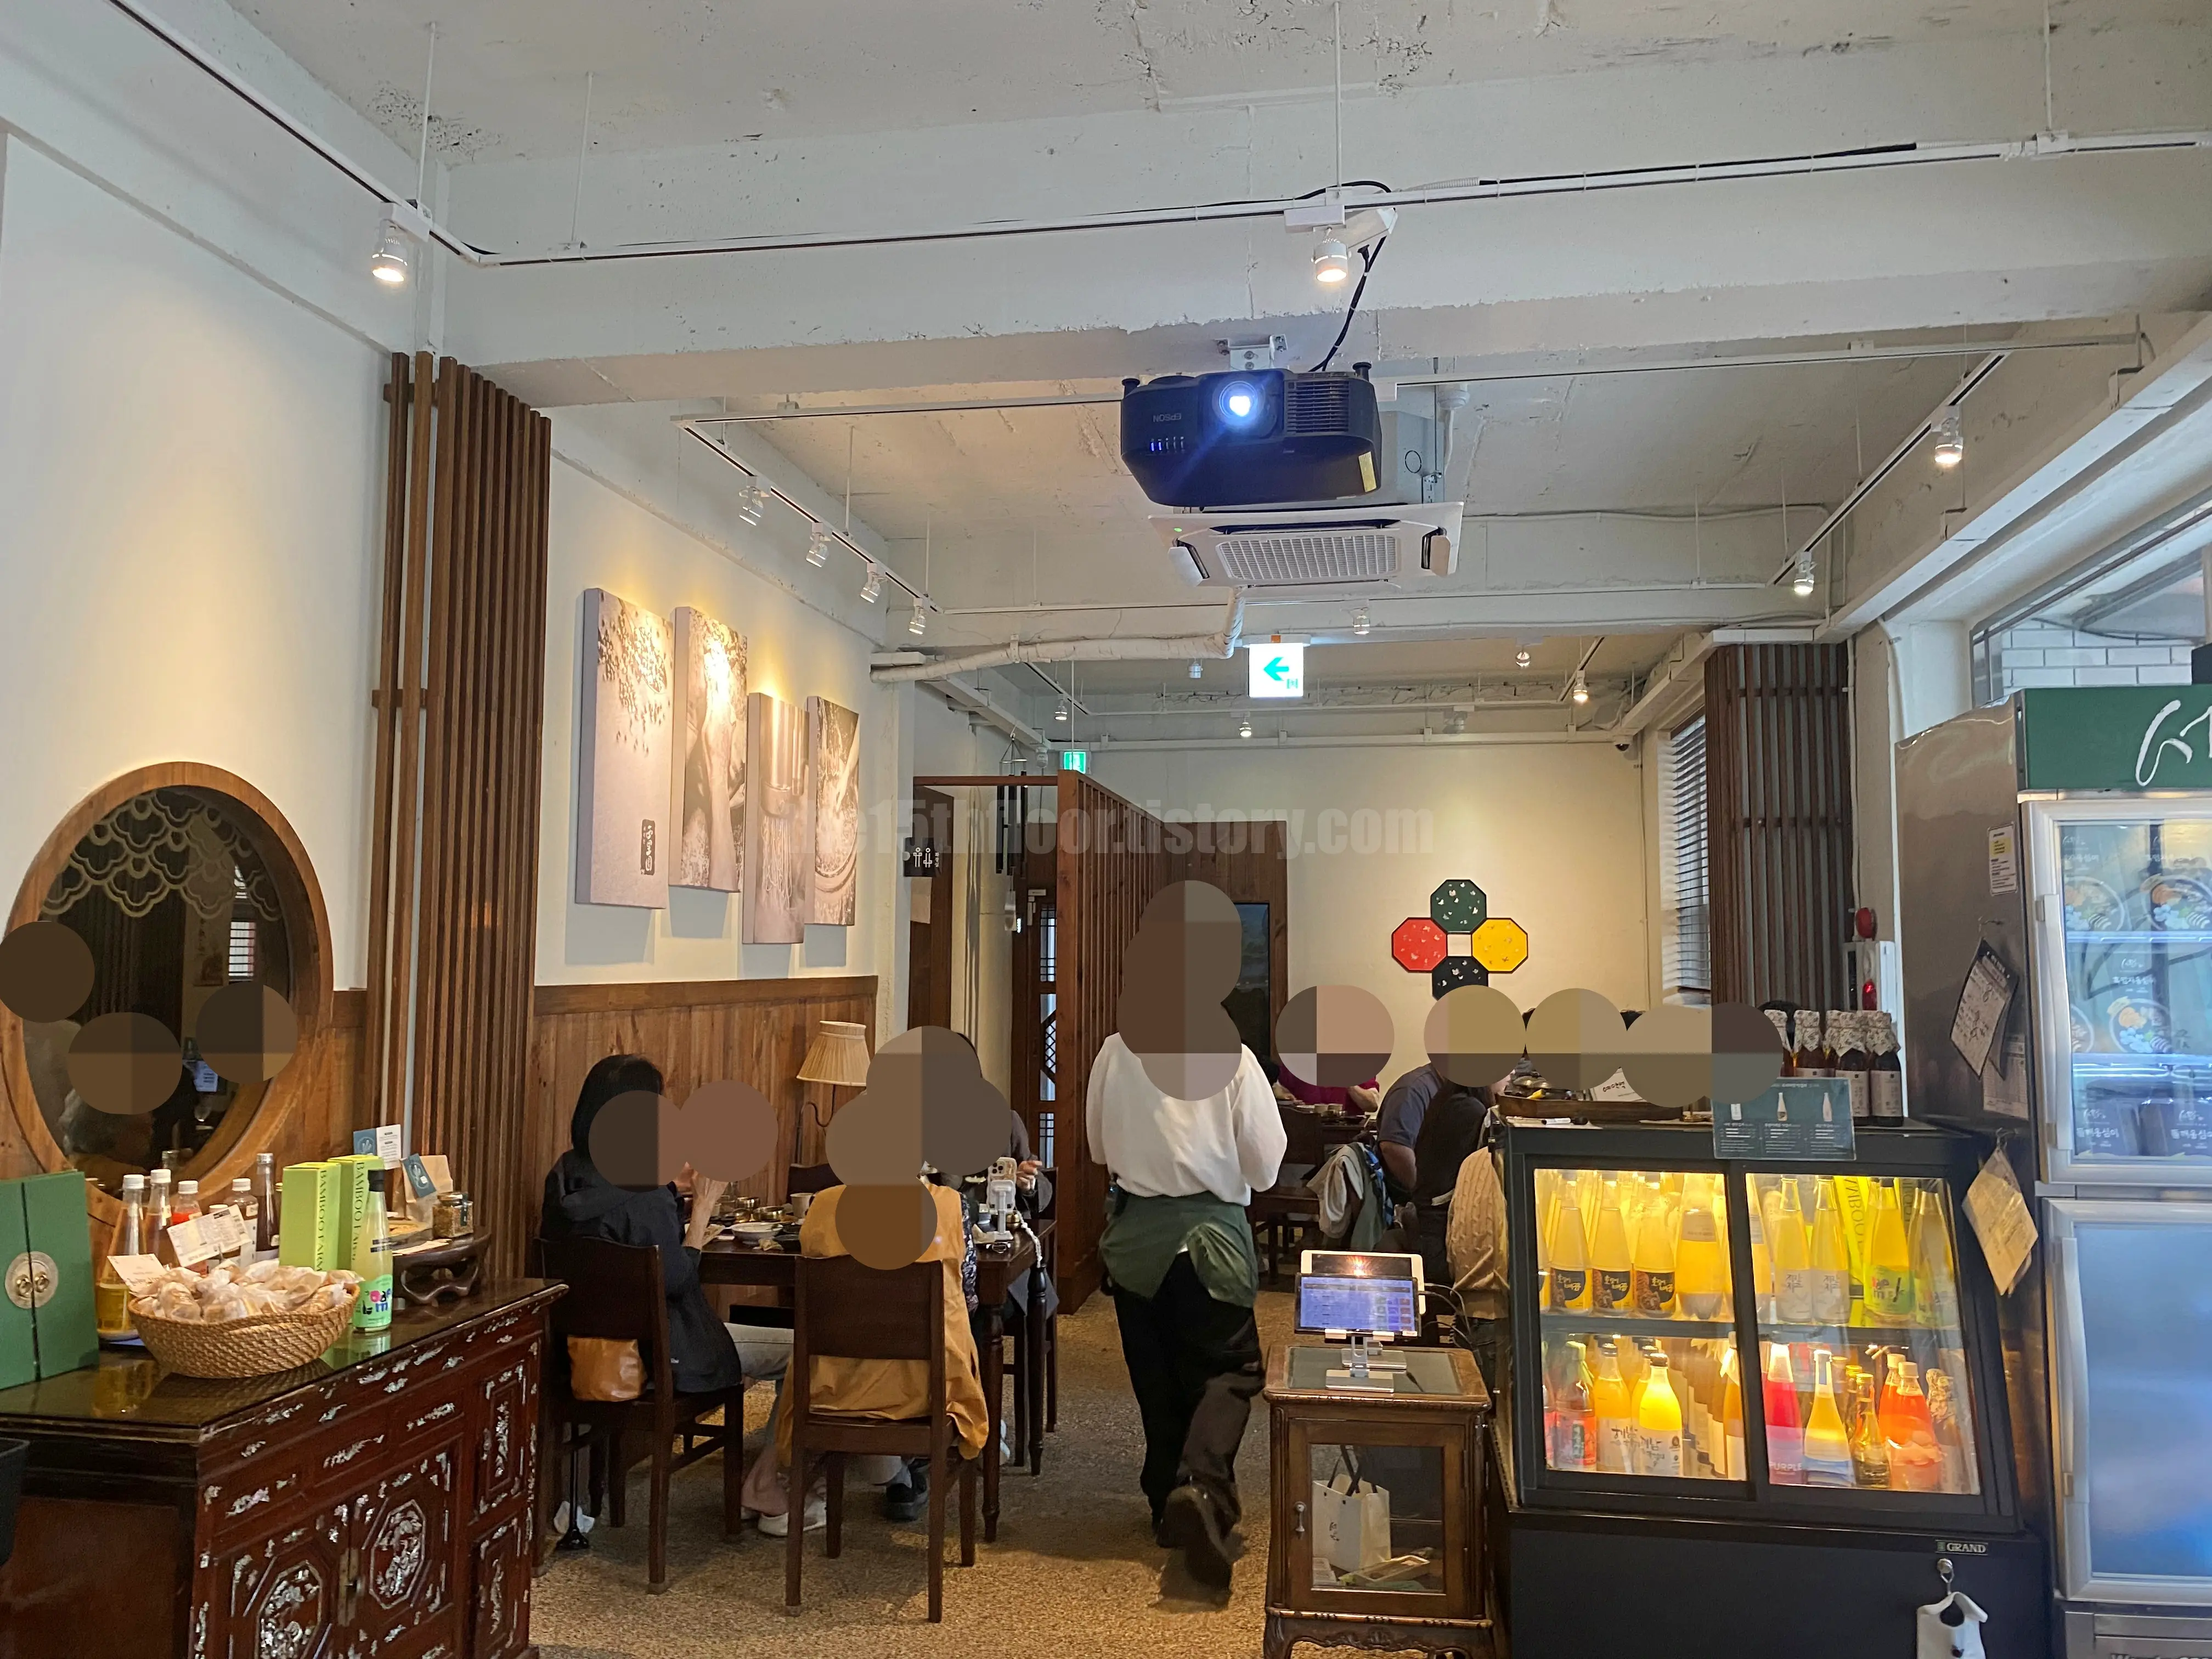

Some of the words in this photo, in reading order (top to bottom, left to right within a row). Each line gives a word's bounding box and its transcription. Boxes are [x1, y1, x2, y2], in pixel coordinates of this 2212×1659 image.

[1153, 413, 1181, 422] EPSON
[354, 1162, 365, 1221] BAMBOO
[318, 1170, 327, 1231] BAMBOO
[1769, 1461, 1803, 1471] PURPLE
[1946, 1542, 1986, 1553] GRAND
